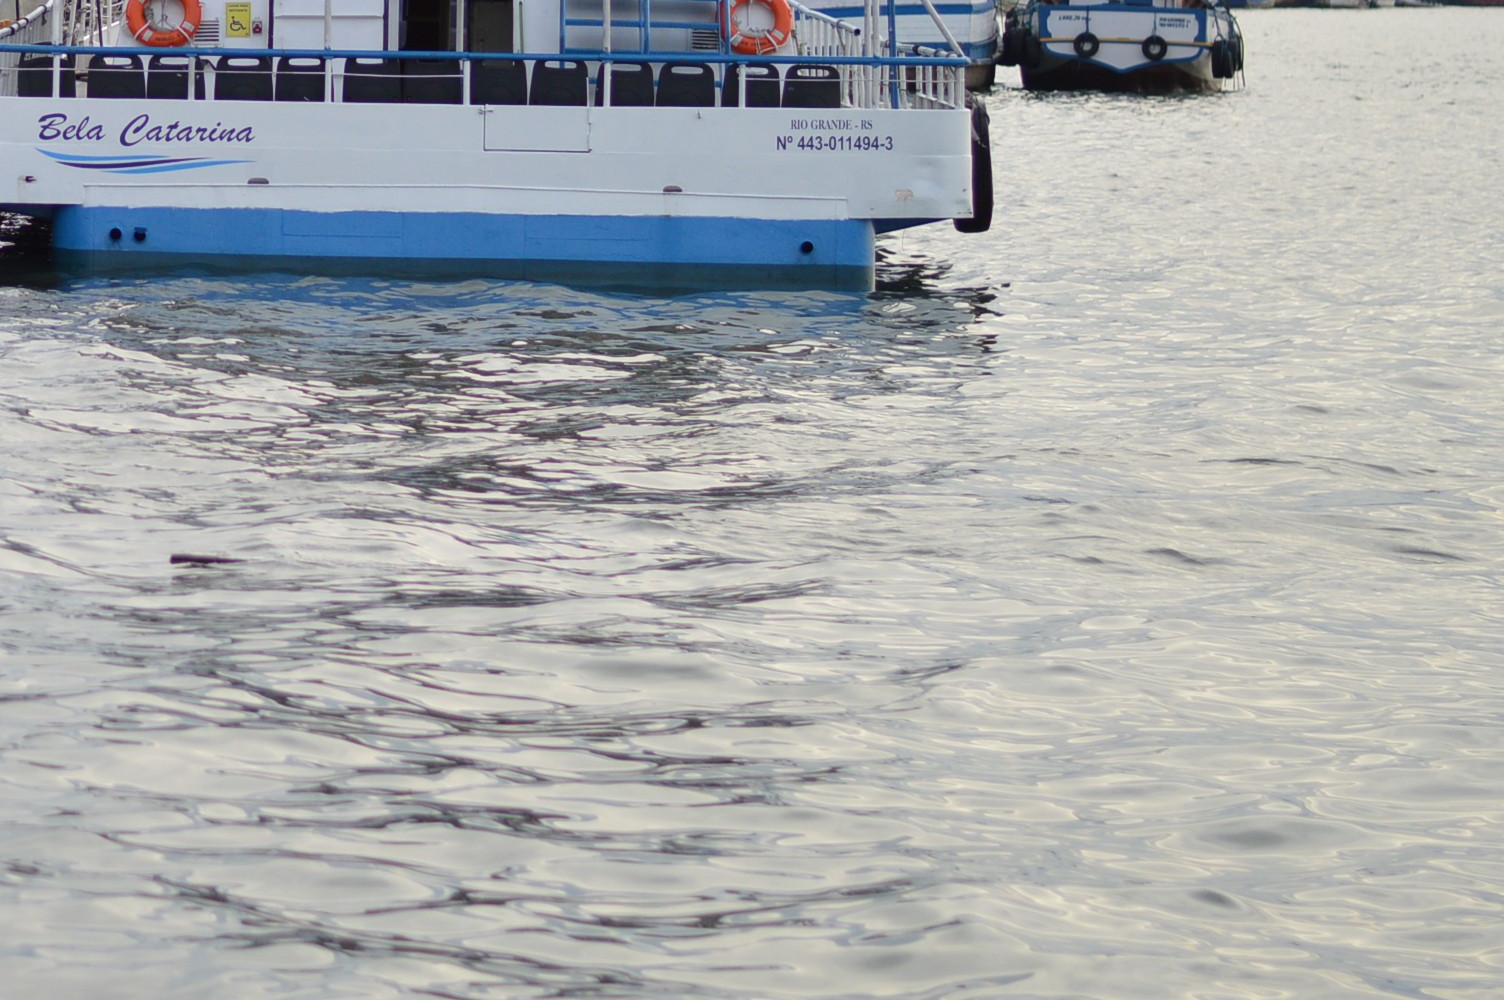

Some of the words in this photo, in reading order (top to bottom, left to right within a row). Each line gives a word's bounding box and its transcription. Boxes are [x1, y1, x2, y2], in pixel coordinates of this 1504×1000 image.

[37, 113, 106, 141] Bela
[119, 113, 256, 147] Catarina
[791, 119, 808, 130] RIO
[810, 119, 853, 130] GRANDE
[860, 119, 873, 130] RS
[797, 135, 894, 151] 443-011494-3
